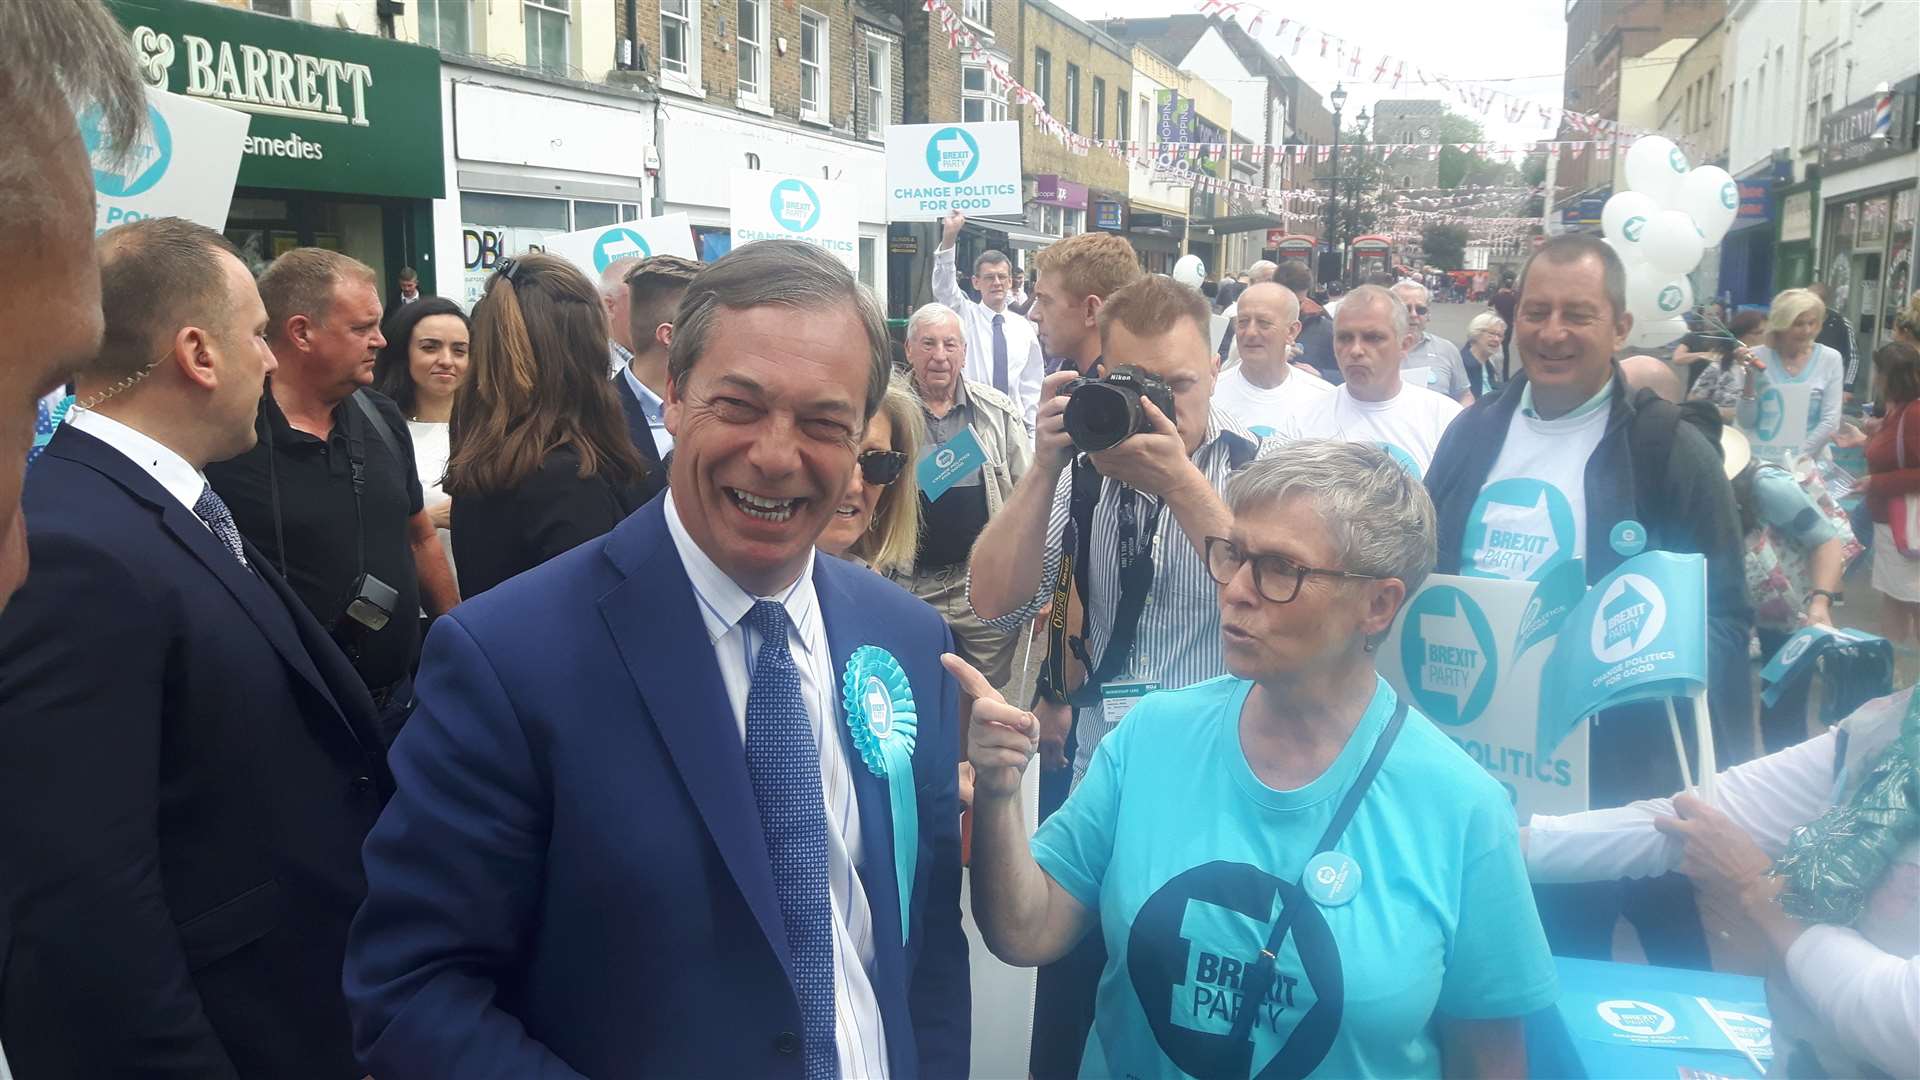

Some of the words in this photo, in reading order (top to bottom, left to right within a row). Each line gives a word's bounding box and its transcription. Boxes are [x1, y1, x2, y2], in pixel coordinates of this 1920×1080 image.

[132, 26, 176, 91] &
[183, 35, 373, 127] BARRETT
[243, 132, 323, 160] emedies
[942, 151, 969, 160] BREXIT
[942, 160, 966, 168] PARTY
[894, 187, 951, 199] CHANGE
[954, 184, 1015, 196] POLITICS
[919, 200, 948, 211] FOR
[951, 198, 991, 209] GOOD
[1489, 529, 1550, 555] BREXIT
[1483, 548, 1533, 572] PARTY
[1607, 602, 1648, 631] BREXIT
[1608, 617, 1641, 643] PARTY
[1428, 643, 1479, 669] BREXIT
[1624, 650, 1676, 669] POLITICS
[1429, 664, 1471, 691] PARTY
[1623, 663, 1655, 678] GOOD
[1450, 736, 1572, 787] OLITICS
